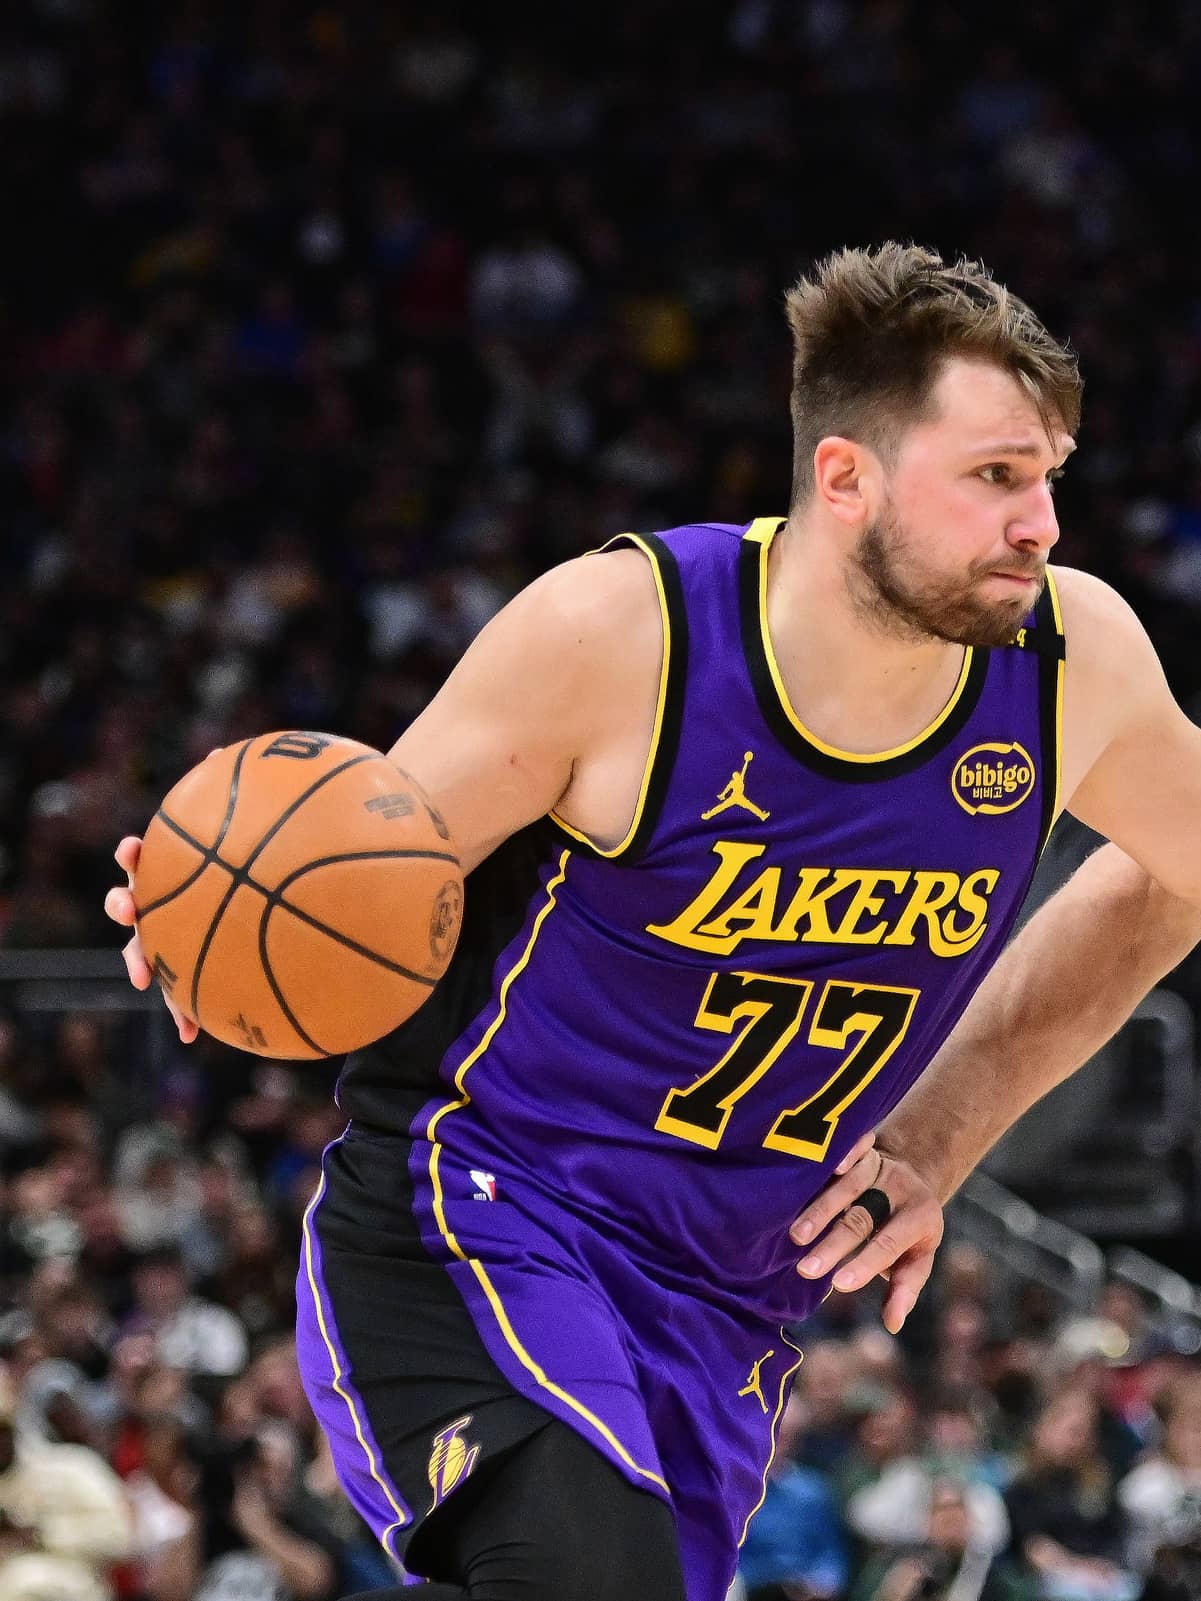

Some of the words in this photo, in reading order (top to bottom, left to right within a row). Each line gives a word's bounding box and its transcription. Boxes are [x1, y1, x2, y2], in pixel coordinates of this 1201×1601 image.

[960, 762, 1030, 793] bibigo
[973, 786, 1003, 799] 비비고
[645, 839, 1001, 958] LAKERS
[654, 971, 921, 1163] 77
